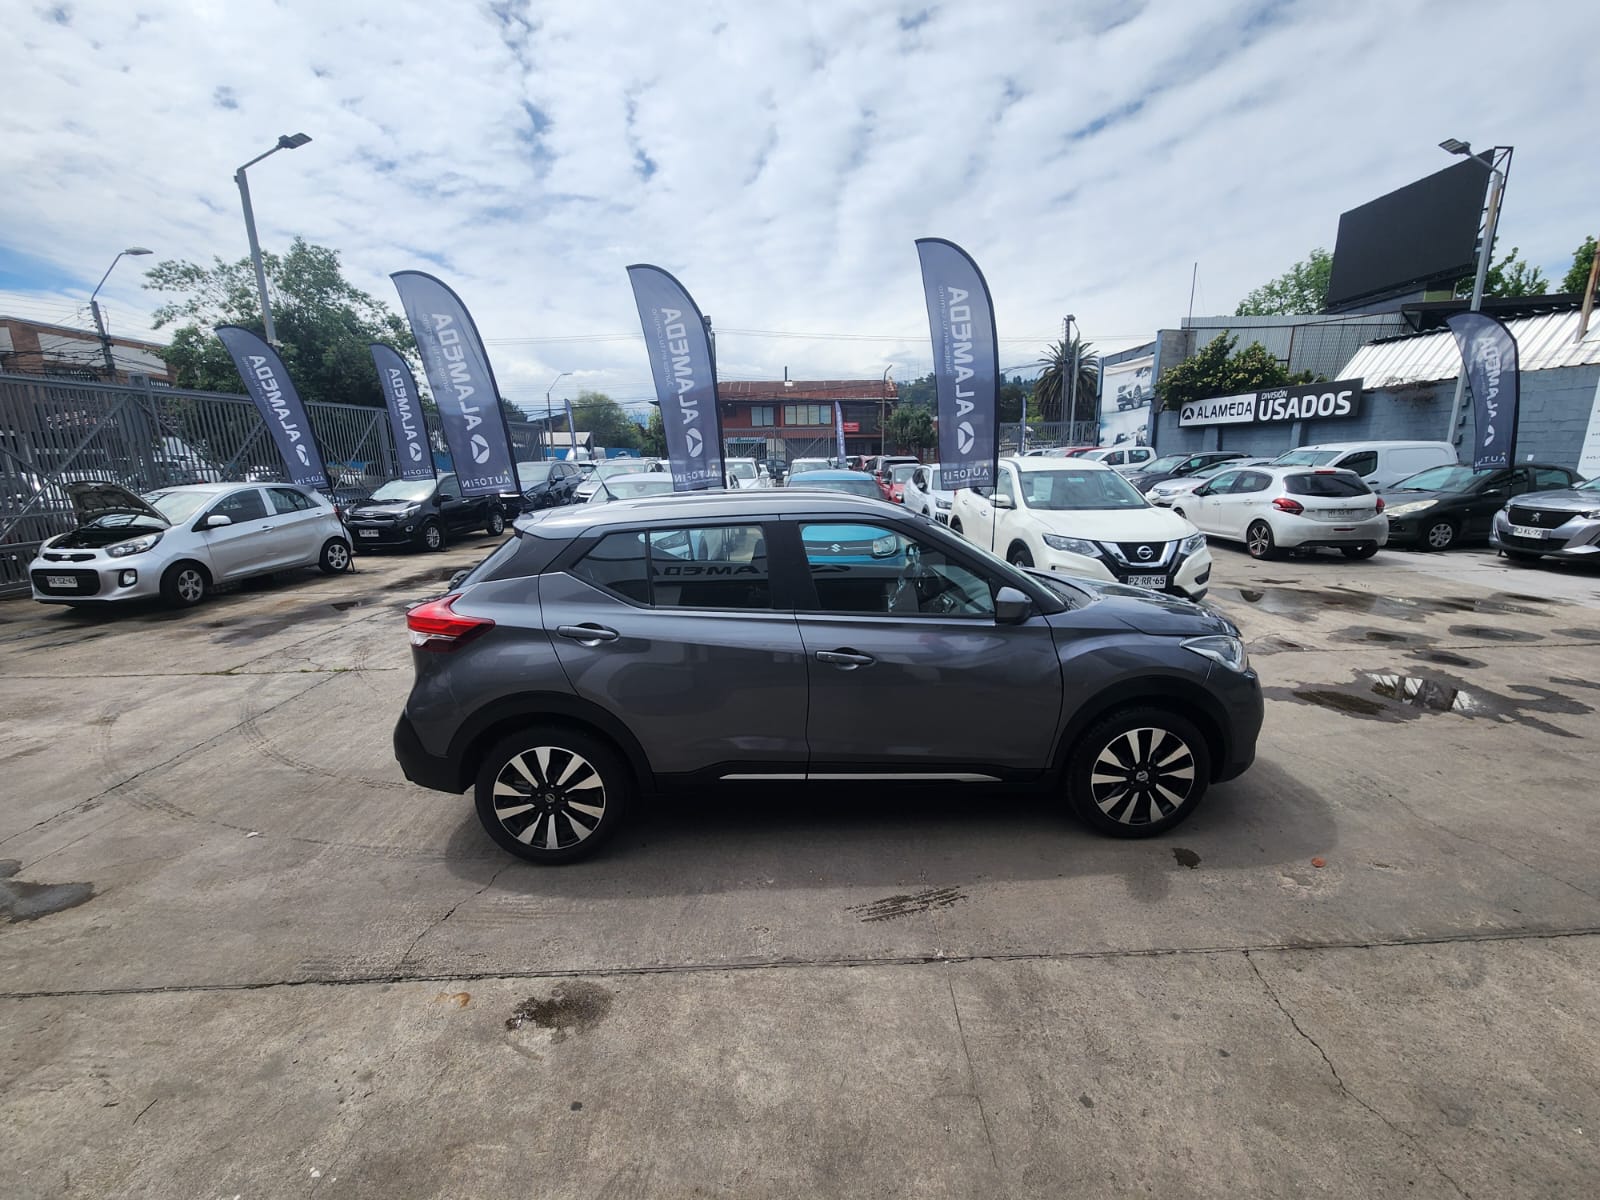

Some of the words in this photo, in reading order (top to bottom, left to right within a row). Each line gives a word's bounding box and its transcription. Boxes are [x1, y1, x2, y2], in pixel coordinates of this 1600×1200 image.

[1261, 389, 1288, 400] DIVISIÓN
[1196, 402, 1253, 419] ALAMEDA
[1258, 390, 1353, 422] USADOS
